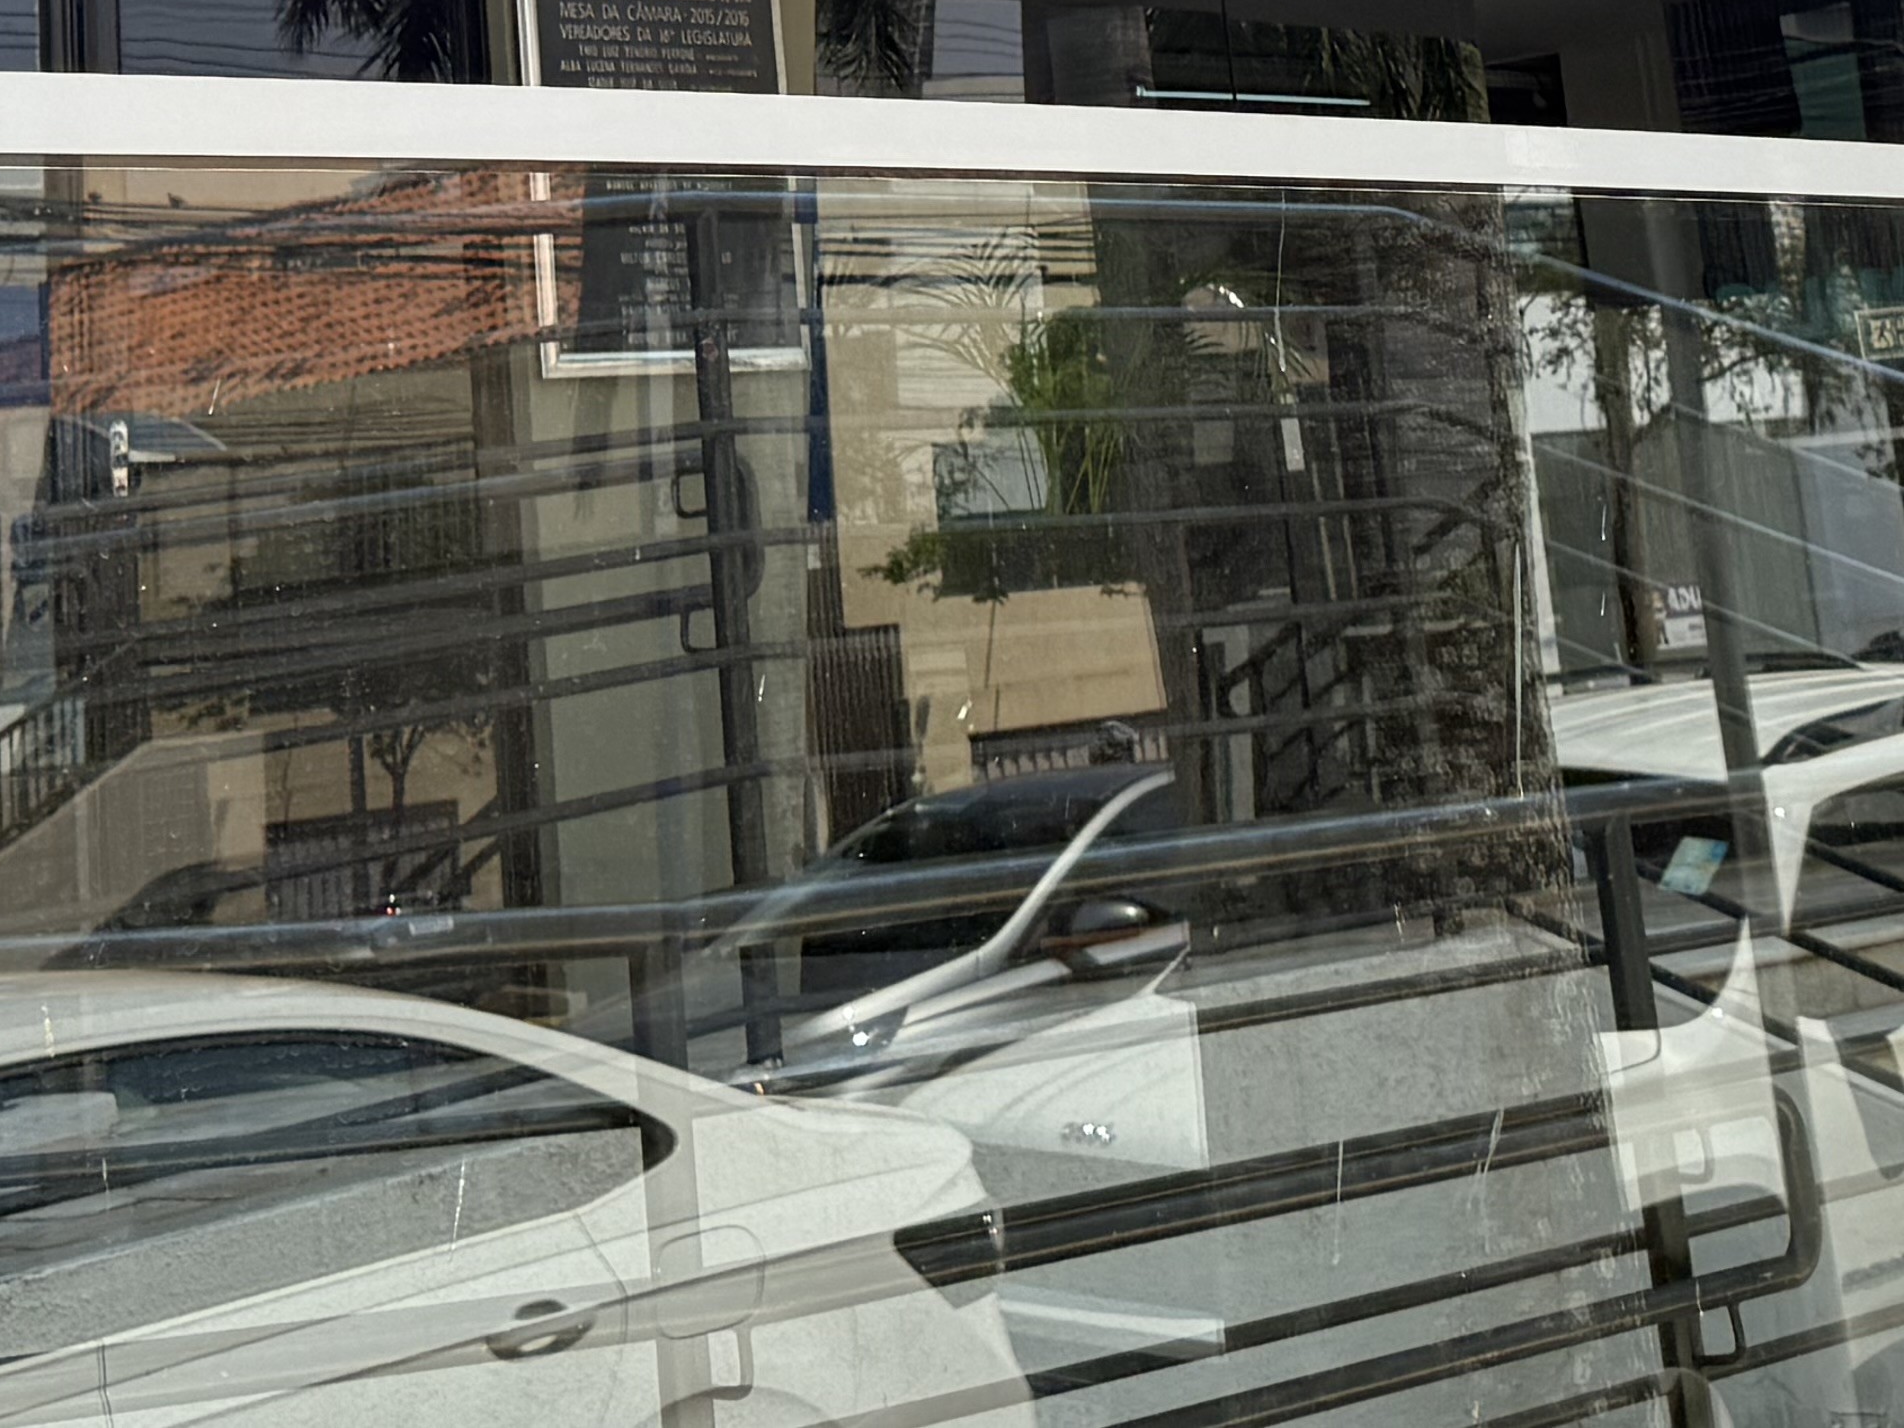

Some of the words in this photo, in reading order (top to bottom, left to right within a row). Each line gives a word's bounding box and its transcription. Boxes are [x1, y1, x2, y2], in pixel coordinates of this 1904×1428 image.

[559, 2, 595, 20] MESA
[602, 3, 620, 20] DA
[627, 1, 683, 23] CÂMARA
[559, 24, 631, 42] VEREADORES
[637, 27, 654, 42] DA
[681, 29, 753, 47] LEGISLATURA
